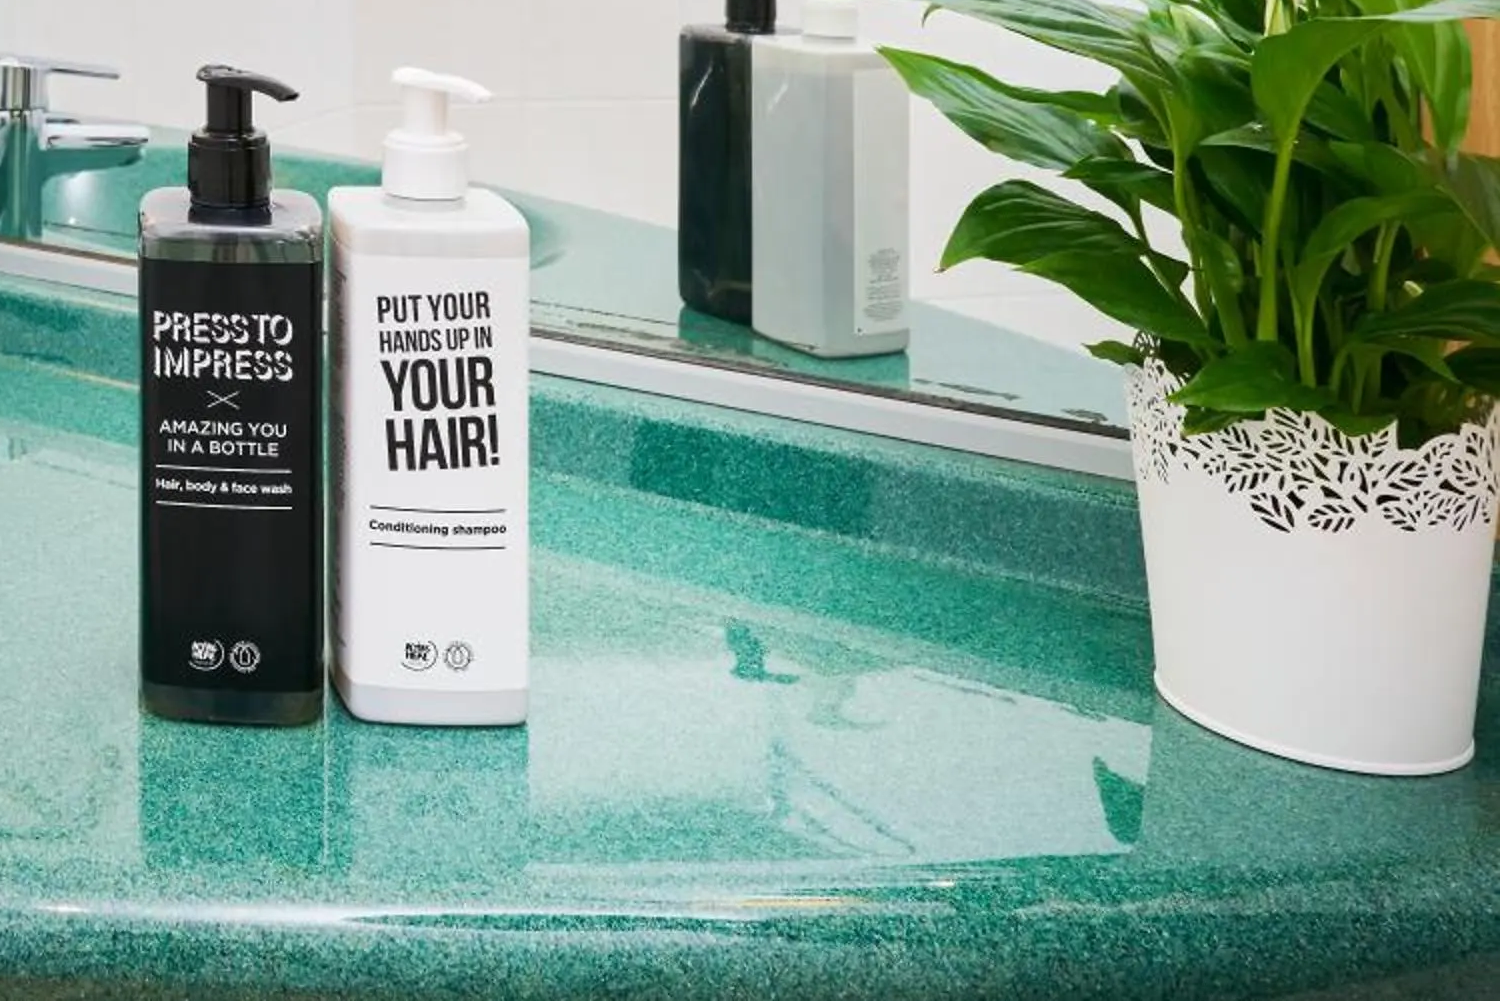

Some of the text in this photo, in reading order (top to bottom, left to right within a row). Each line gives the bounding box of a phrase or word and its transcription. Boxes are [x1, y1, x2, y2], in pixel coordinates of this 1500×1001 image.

[376, 291, 491, 323] PUT YOUR
[153, 310, 294, 346] PRESS TO
[379, 326, 493, 353] HANDS UP IN
[153, 346, 294, 382] IMPRESS
[380, 356, 496, 412] YOUR
[159, 419, 288, 438] AMAZING YOU
[385, 413, 500, 471] HAIR!
[167, 439, 279, 457] IN A BOTTLE
[155, 478, 293, 495] Hair, body & face wash
[369, 519, 507, 537] Conditioning shampoo
